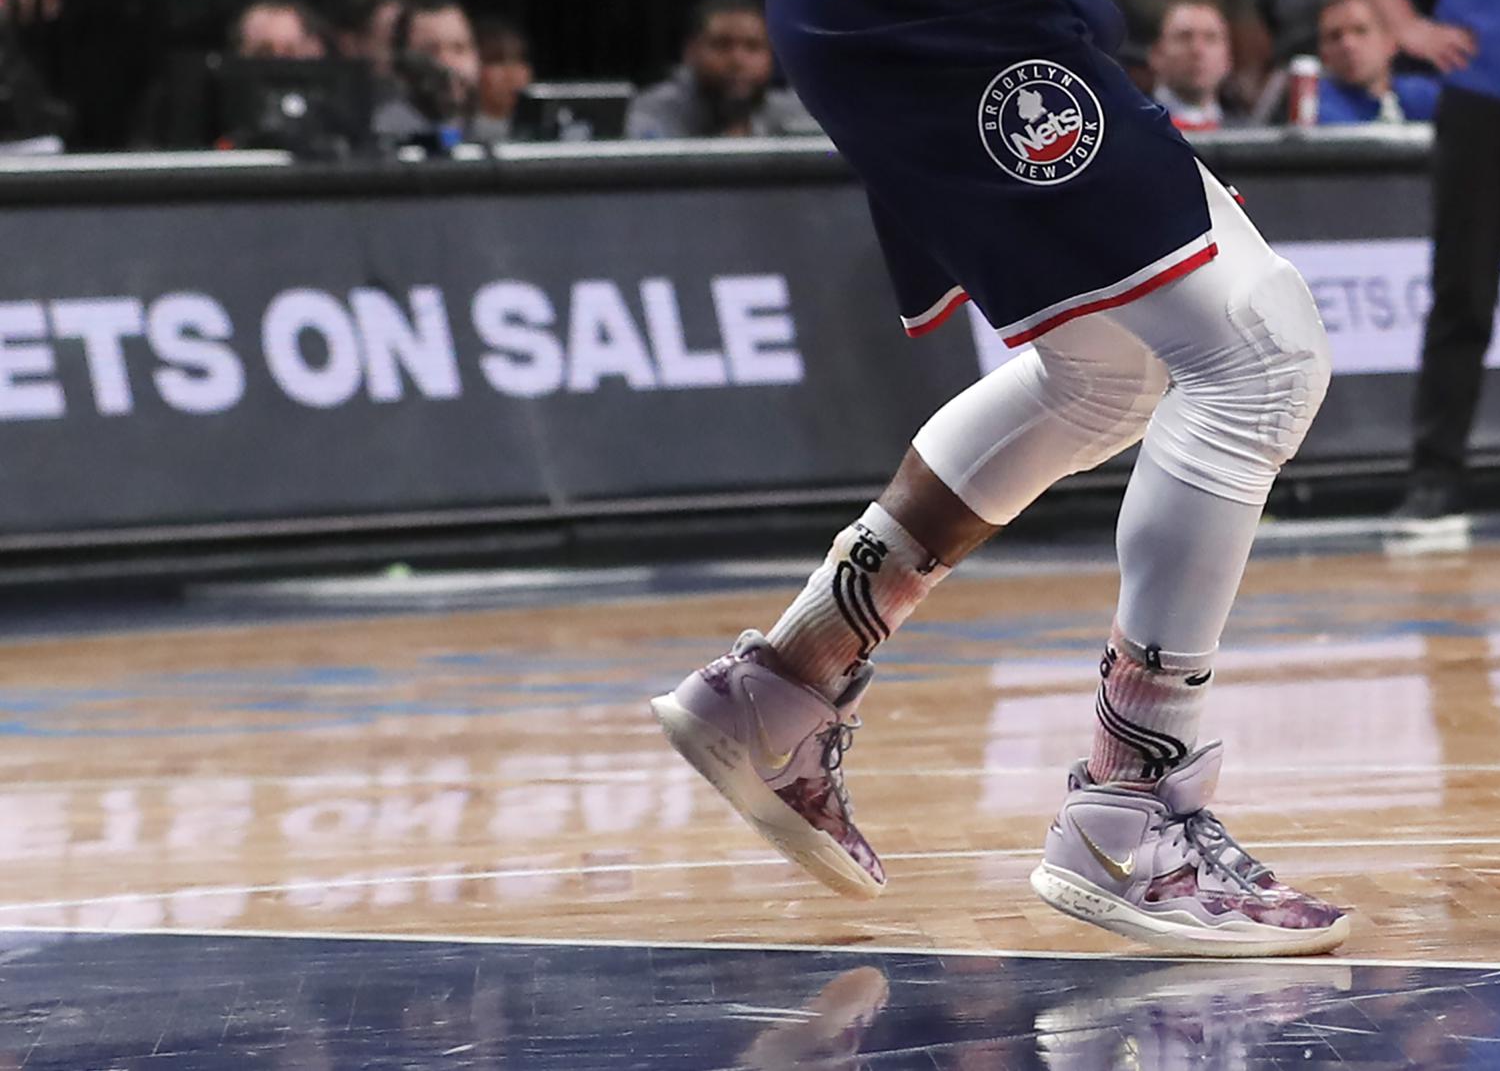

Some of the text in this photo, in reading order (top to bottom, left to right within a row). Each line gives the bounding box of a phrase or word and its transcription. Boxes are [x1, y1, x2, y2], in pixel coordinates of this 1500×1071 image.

[985, 66, 1072, 130] BROOKLYN
[1010, 108, 1081, 159] Nets
[1016, 121, 1098, 178] NEW YORK
[262, 288, 462, 408] ON
[471, 274, 804, 398] SALE
